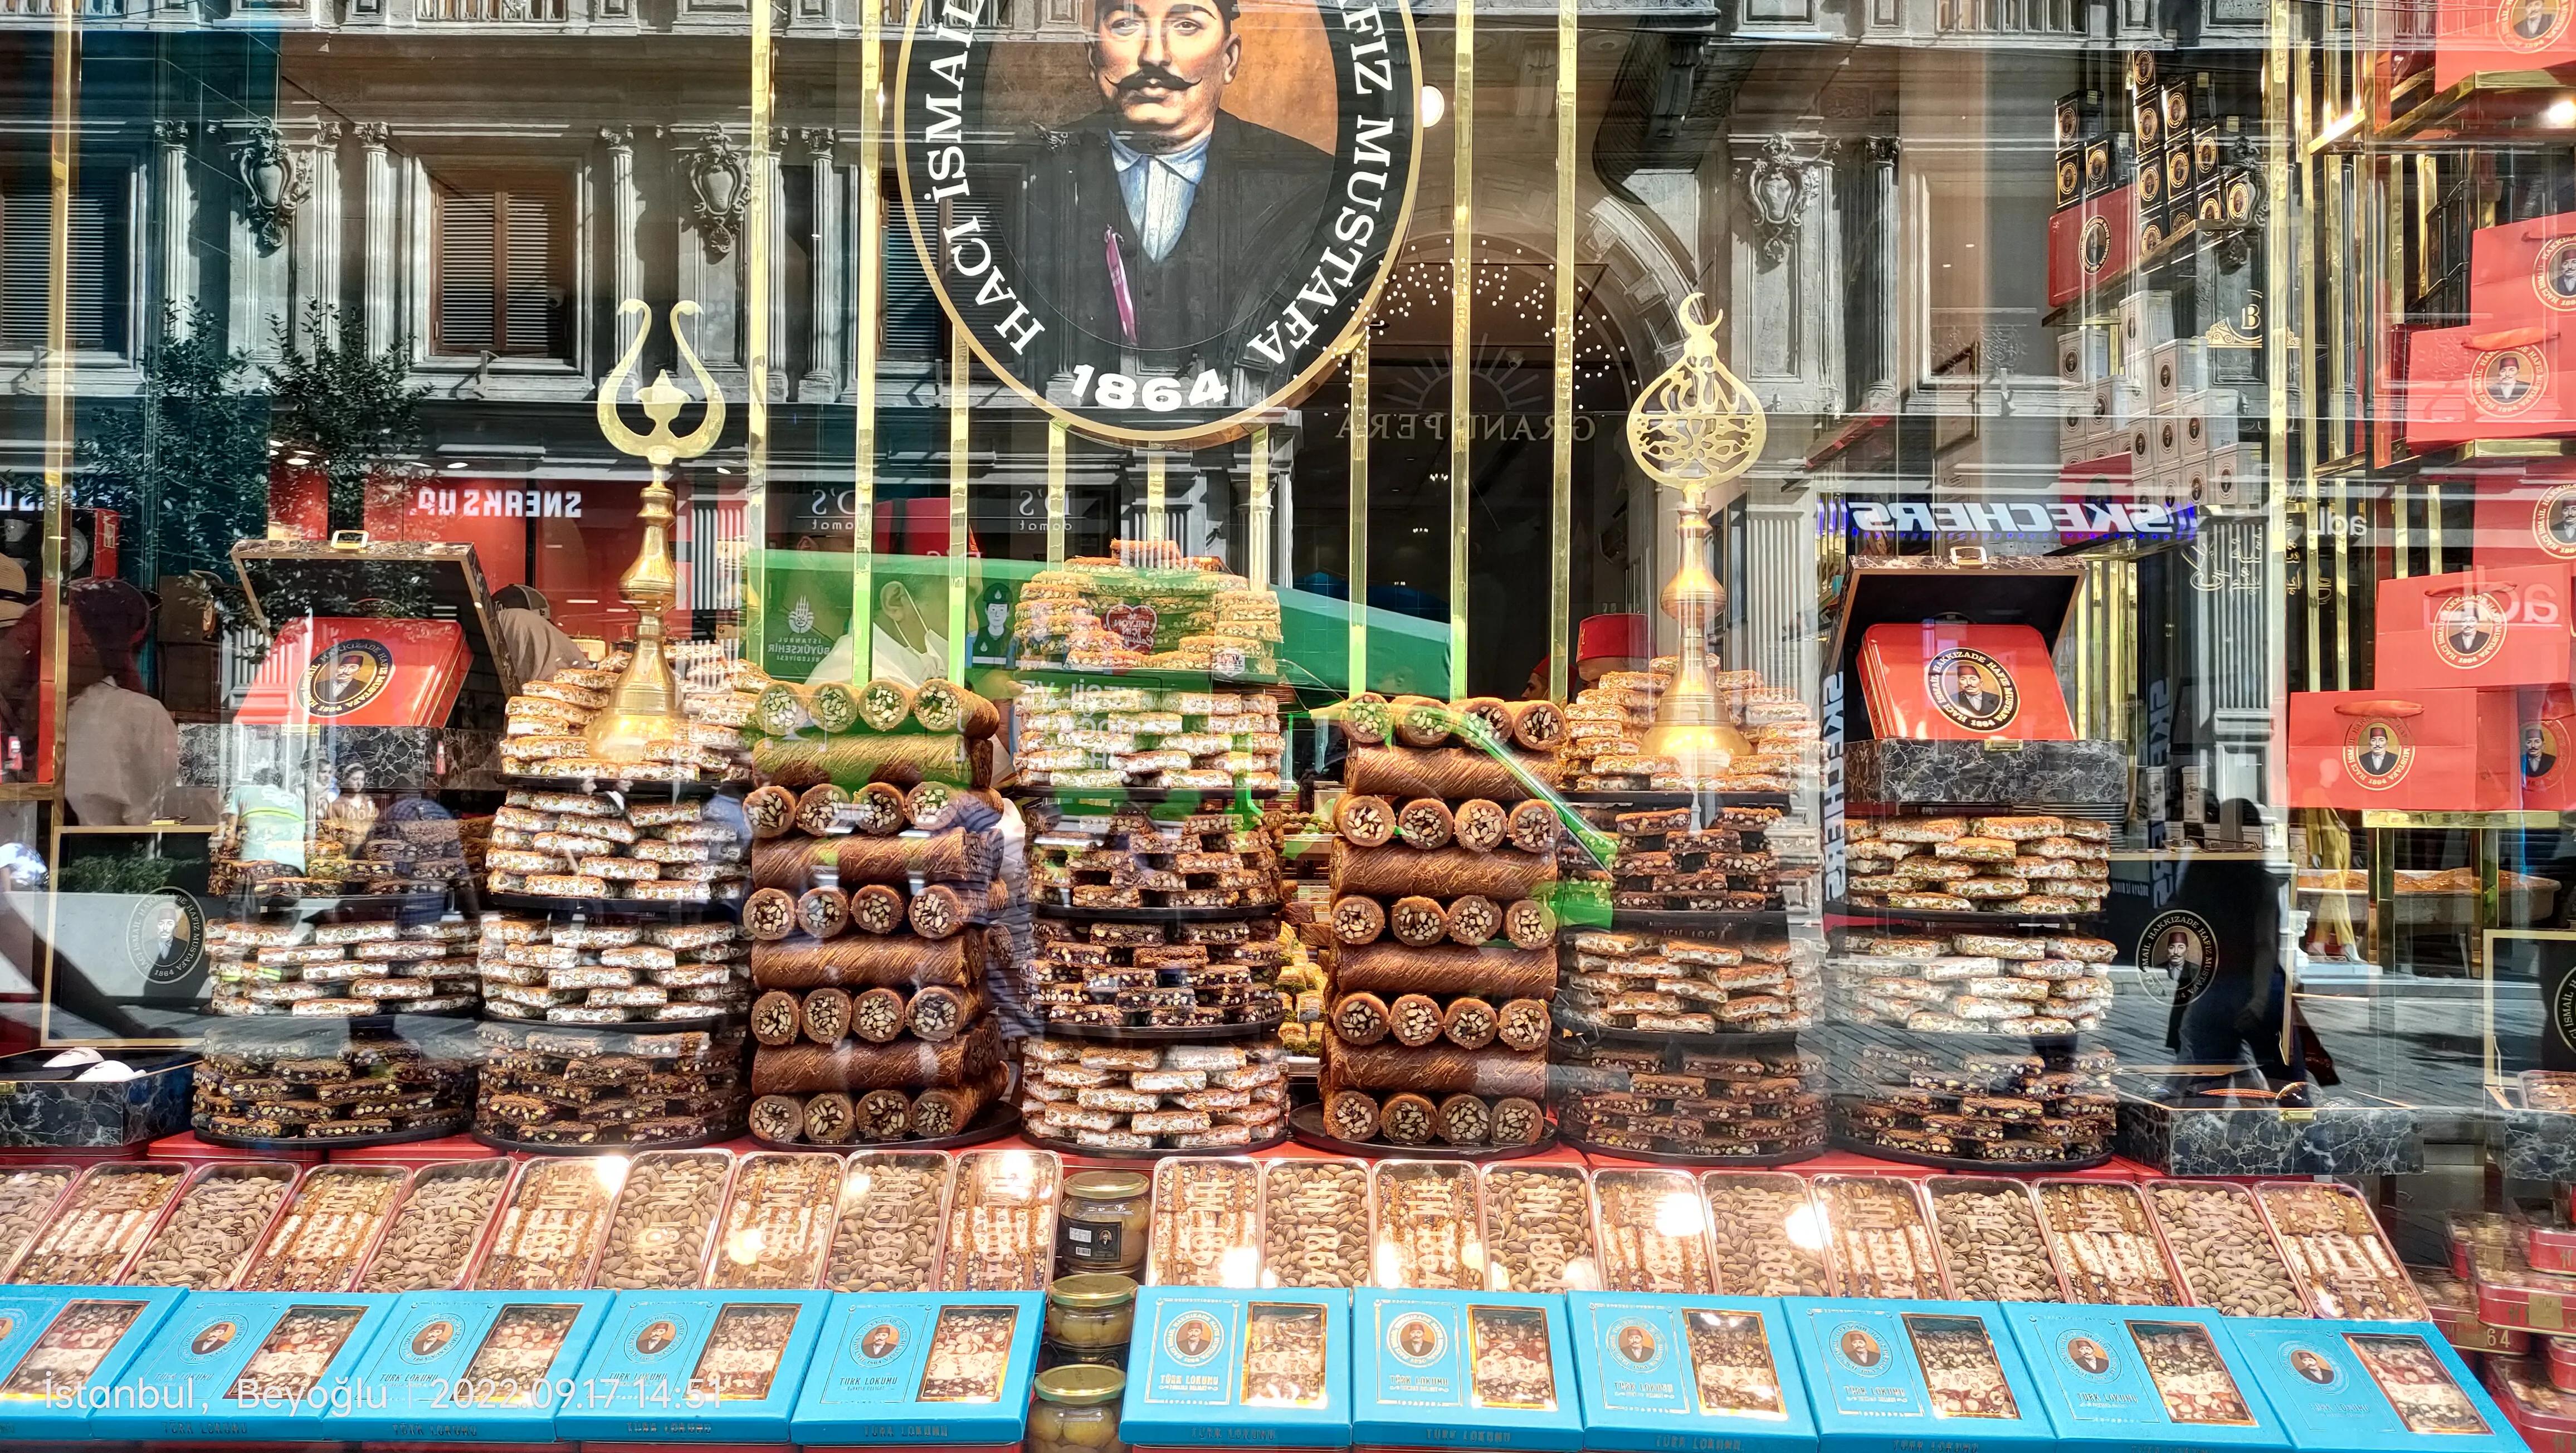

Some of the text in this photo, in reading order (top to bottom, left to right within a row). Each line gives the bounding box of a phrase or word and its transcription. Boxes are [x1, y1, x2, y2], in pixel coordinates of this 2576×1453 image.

[924, 0, 1394, 365] HACI İSMAİL FIZ MUSTAFA
[1070, 364, 1230, 412] 1864
[1933, 651, 1985, 672] HAKKIZADE
[1943, 704, 1967, 723] HACI
[187, 904, 200, 931] HAFIZ
[2148, 916, 2199, 940] HAKKIZADE
[176, 933, 201, 971] MUSTAFA
[2198, 928, 2212, 954] HAFIZ
[2187, 957, 2212, 994] MUSTAFA
[864, 1221, 914, 1281] 1864
[1189, 1226, 1227, 1285] 1864
[1303, 1227, 1338, 1285] 1864
[1417, 1229, 1451, 1287] 1864
[2487, 1328, 2511, 1348] 64
[865, 1377, 898, 1385] LOKUMU
[1185, 1375, 1219, 1385] LOKUMU
[1416, 1376, 1449, 1386] LOKUMU
